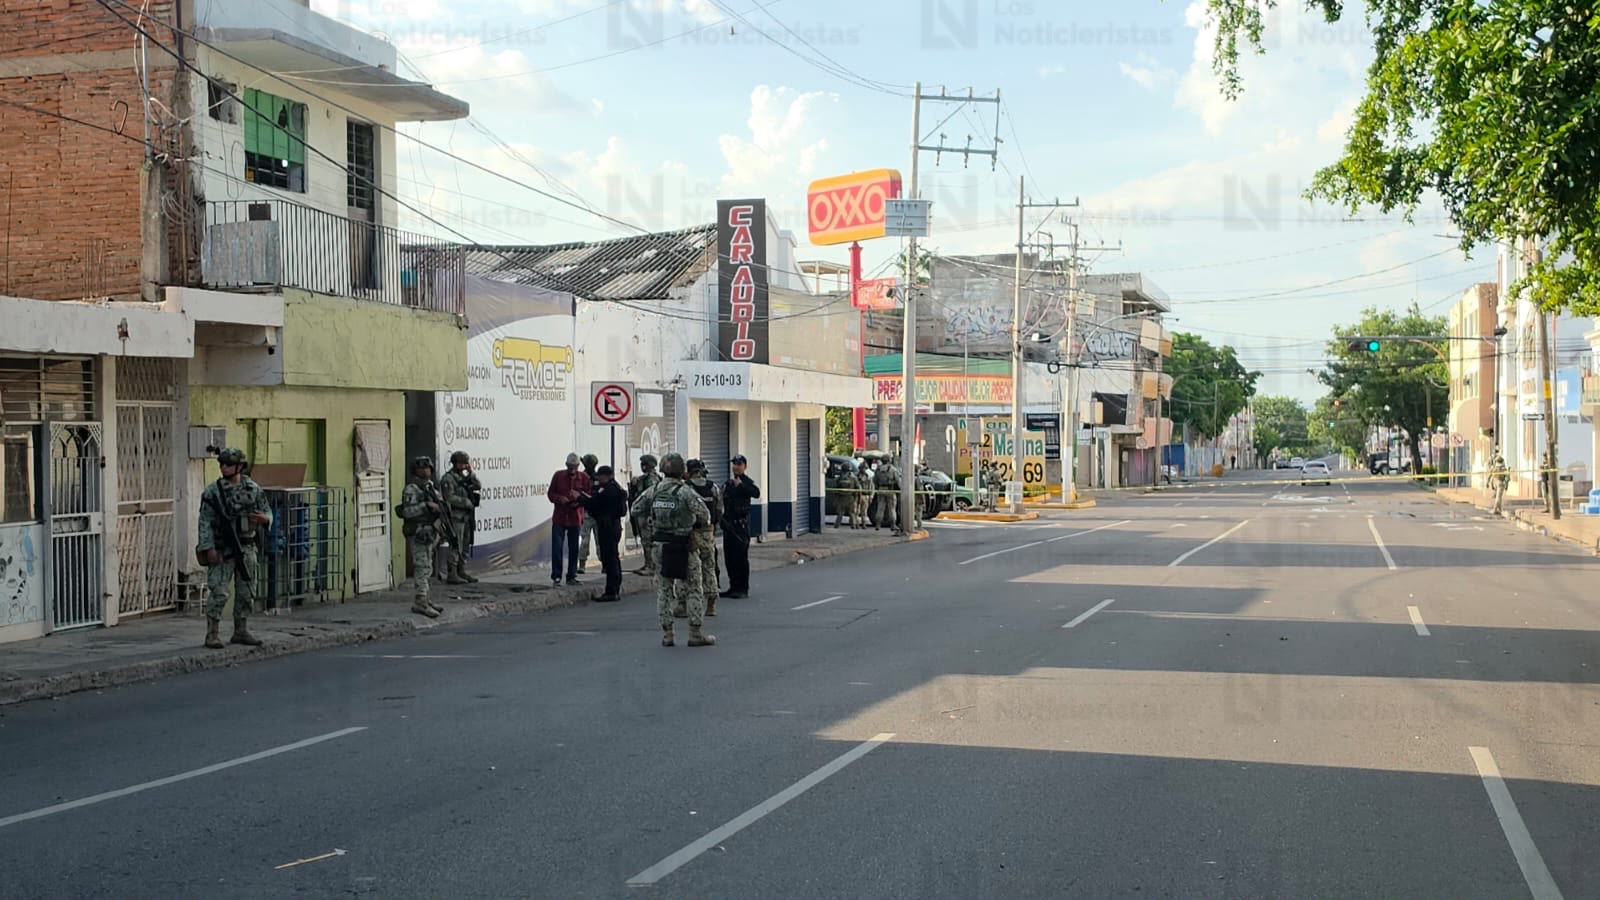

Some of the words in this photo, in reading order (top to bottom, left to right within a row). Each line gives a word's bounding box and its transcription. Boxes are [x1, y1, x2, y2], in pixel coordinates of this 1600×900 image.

[809, 182, 886, 230] OXXO
[729, 205, 754, 264] CAR
[731, 265, 755, 360] AUDIO
[520, 390, 567, 401] SUSPENSIONES
[455, 396, 495, 411] ALINEACIÓN
[455, 428, 490, 440] BALANCEO
[487, 456, 511, 471] CLUTCH
[493, 486, 501, 500] DE
[502, 485, 524, 499] DISCOS
[483, 518, 492, 531] DE
[493, 515, 513, 530] ACEITE
